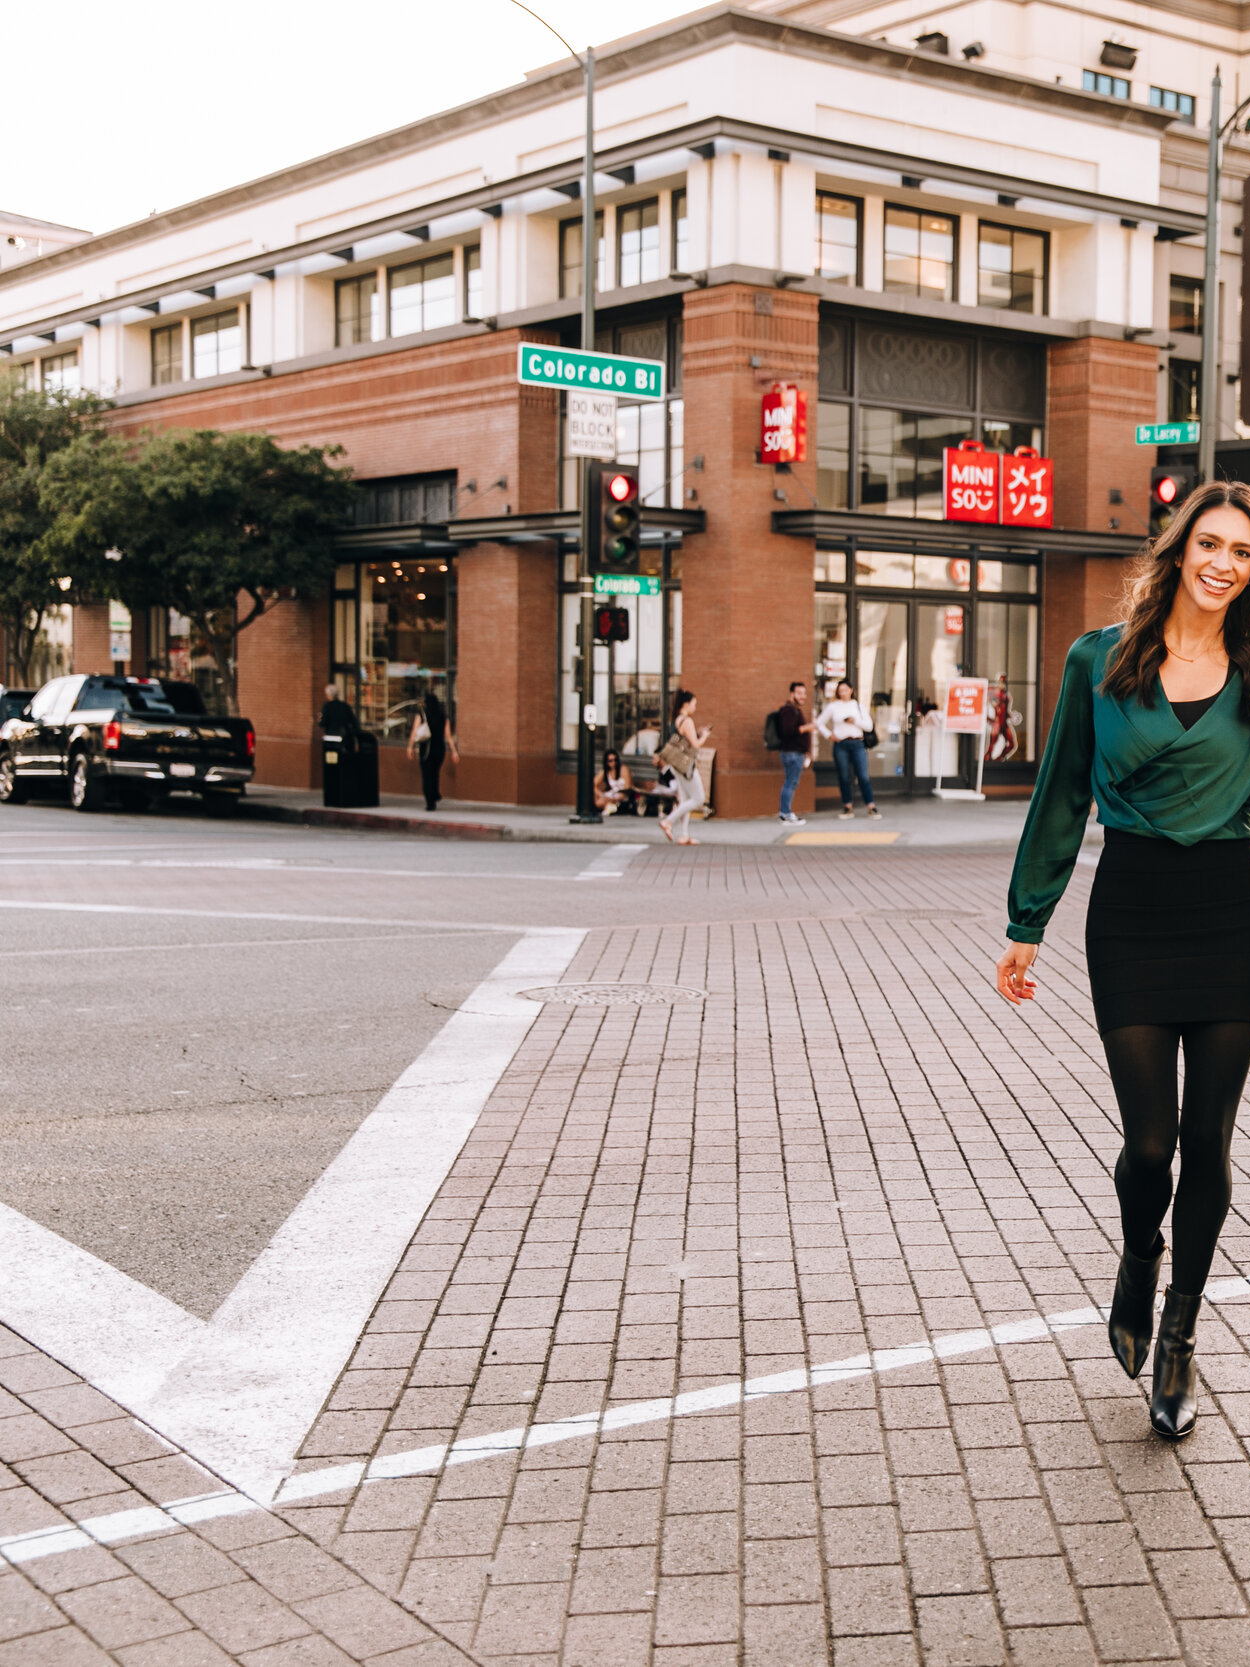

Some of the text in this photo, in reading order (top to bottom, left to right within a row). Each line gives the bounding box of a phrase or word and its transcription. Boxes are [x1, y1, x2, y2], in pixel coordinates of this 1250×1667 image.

[528, 354, 656, 391] Colorado Bl
[572, 400, 614, 416] DO NOT
[764, 405, 793, 427] MINI
[572, 422, 614, 437] BLOCK
[951, 464, 994, 487] MINI
[1008, 465, 1047, 492] メイ
[1009, 492, 1048, 518] ソウ
[595, 575, 641, 594] Colorado
